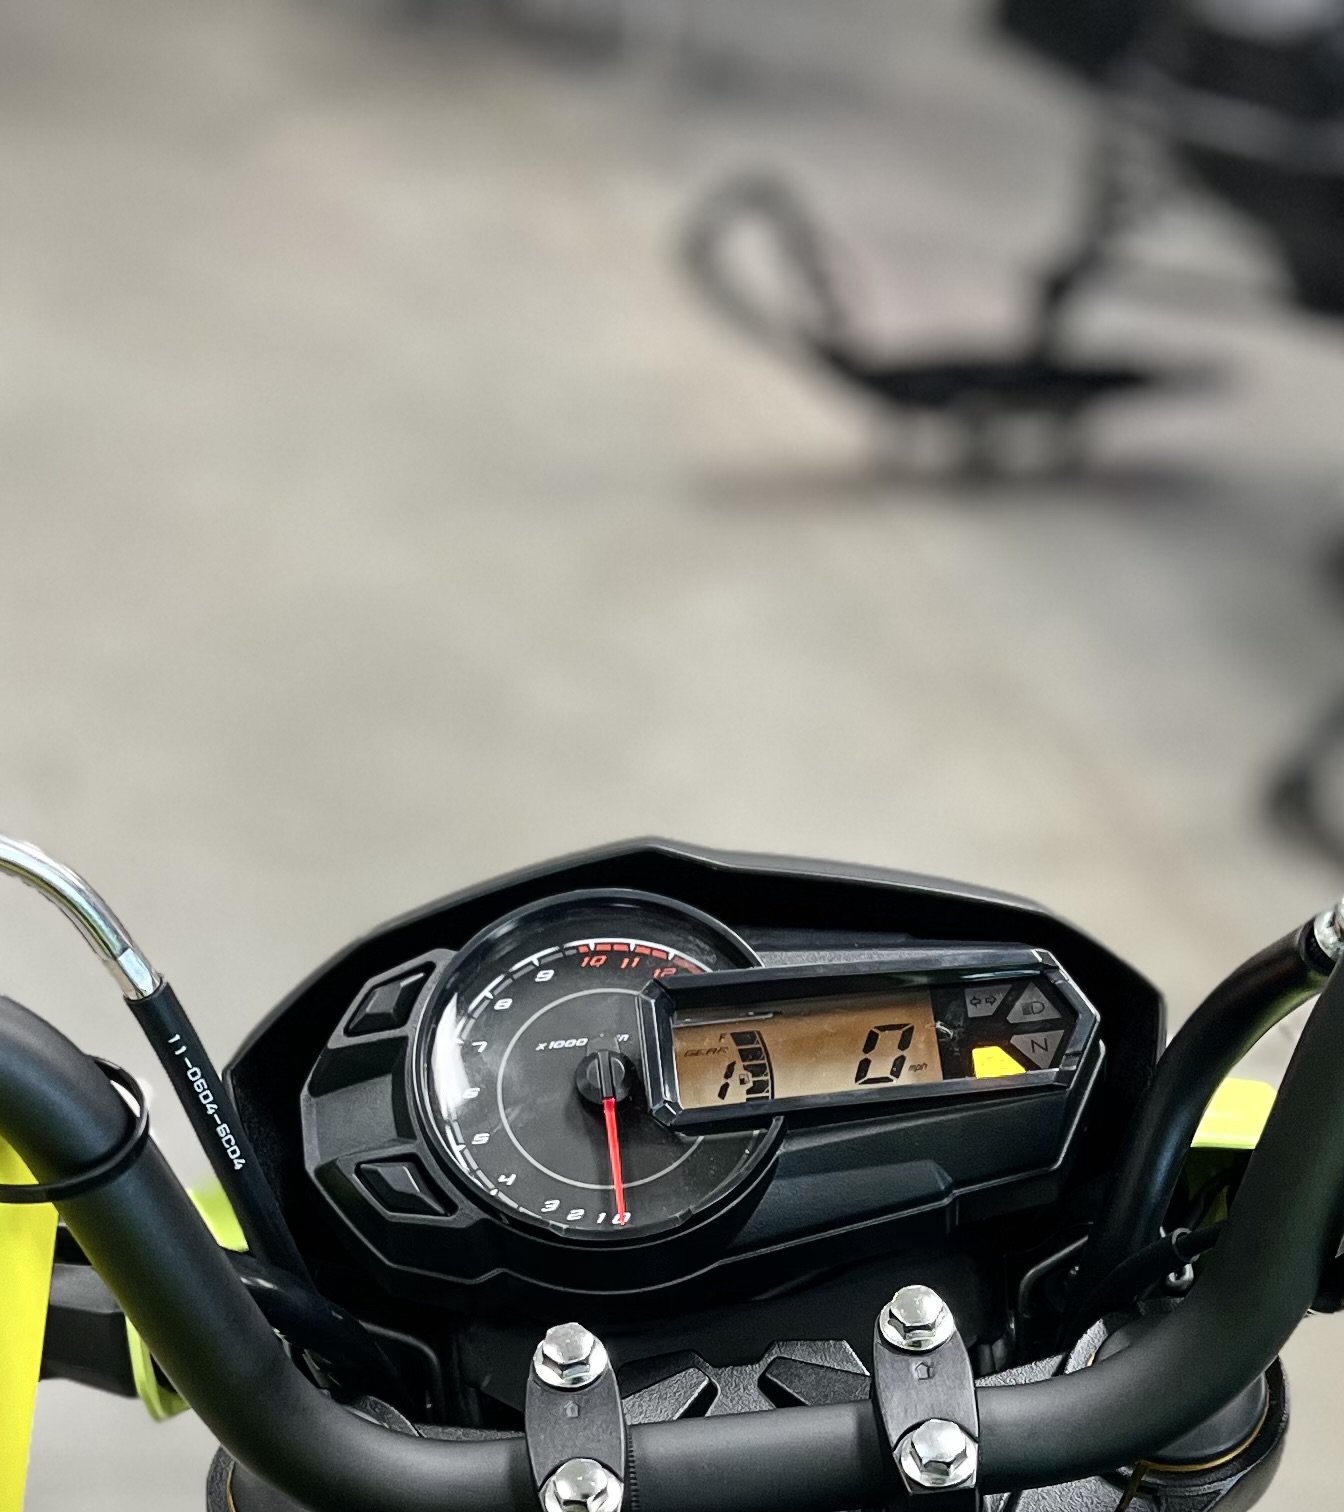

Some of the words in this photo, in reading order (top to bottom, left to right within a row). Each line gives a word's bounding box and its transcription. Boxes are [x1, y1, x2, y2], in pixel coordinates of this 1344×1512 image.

[581, 955, 608, 968] 10
[620, 956, 641, 968] 11
[534, 969, 555, 982] 9
[493, 998, 513, 1010] 8
[471, 1041, 488, 1053] 7
[1030, 1037, 1049, 1054] N
[855, 1023, 914, 1085] 0
[908, 1062, 928, 1074] mph
[462, 1087, 480, 1100] 6
[471, 1132, 490, 1145] 5
[498, 1174, 517, 1186] 4
[541, 1199, 560, 1212] 3
[566, 1208, 585, 1221] 2
[596, 1212, 607, 1224] 1
[612, 1212, 631, 1225] 0
